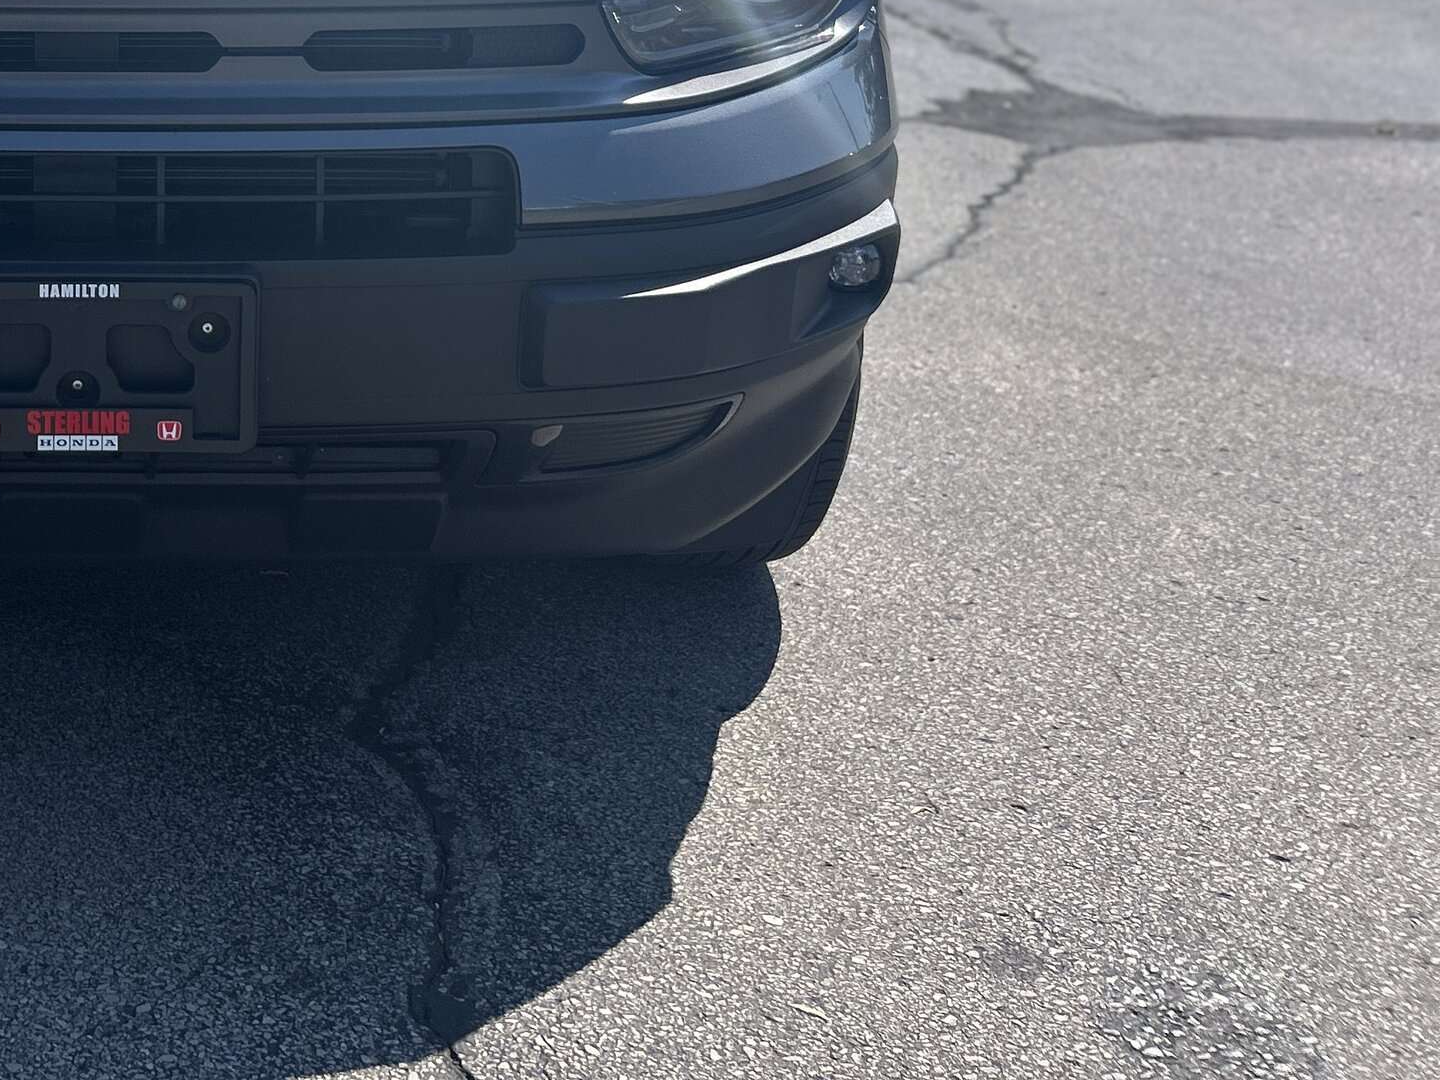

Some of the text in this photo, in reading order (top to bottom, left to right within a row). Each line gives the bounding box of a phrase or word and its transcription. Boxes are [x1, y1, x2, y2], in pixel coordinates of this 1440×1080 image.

[38, 283, 121, 299] HAMILTON
[26, 410, 130, 435] STERLING
[39, 437, 117, 448] HONDA
